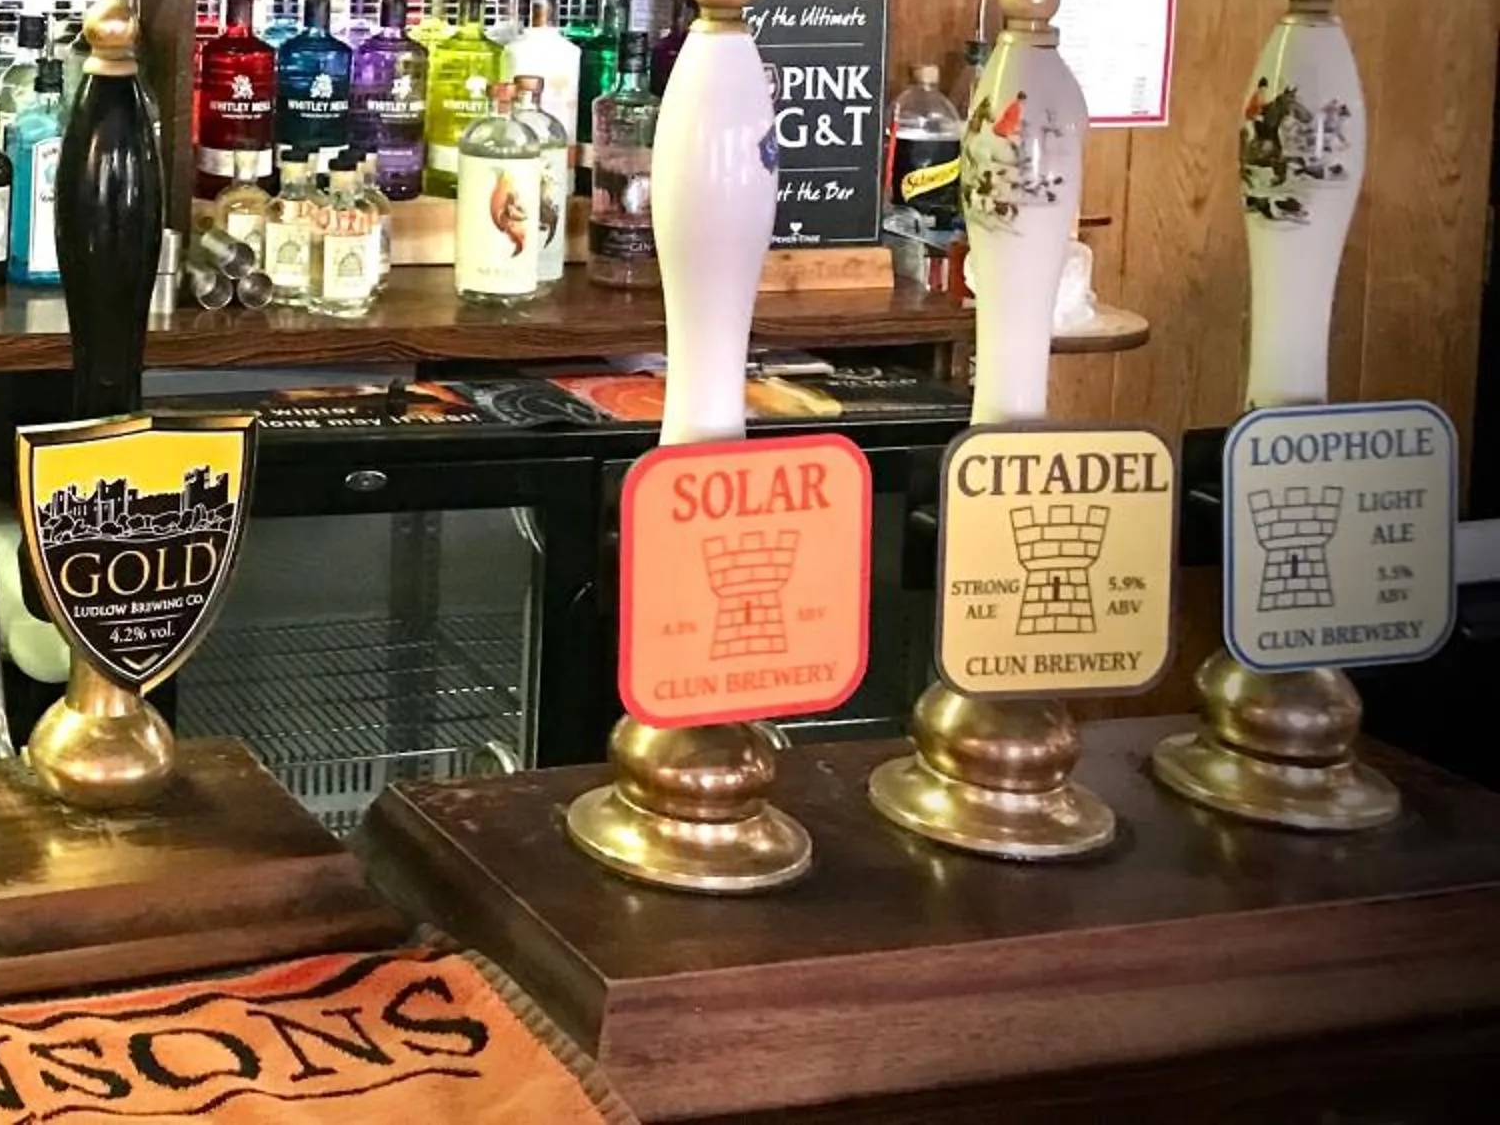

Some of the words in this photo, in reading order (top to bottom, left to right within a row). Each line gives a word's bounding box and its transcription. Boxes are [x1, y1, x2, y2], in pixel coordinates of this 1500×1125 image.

[740, 5, 768, 40] Try
[770, 6, 797, 28] the
[799, 5, 868, 27] Ultimate
[781, 65, 873, 101] PINK
[209, 100, 250, 112] WHITLEY
[288, 99, 329, 113] WHITLEY
[367, 99, 407, 113] WHITLEY
[775, 105, 873, 149] G&T
[796, 182, 821, 202] the
[824, 180, 855, 202] Bar
[629, 242, 651, 252] GIN
[270, 406, 358, 417] winter
[258, 419, 322, 429] long
[328, 418, 381, 427] may
[1249, 427, 1435, 466] LOOPHOLE
[957, 452, 1169, 497] CITADEL
[672, 462, 831, 523] SOLAR
[1358, 488, 1428, 513] LIGHT
[1370, 523, 1415, 545] ALE
[59, 538, 218, 599] GOLD
[951, 578, 1021, 596] STRONG
[1107, 576, 1147, 592] 5.9%
[1378, 587, 1412, 604] ABV
[73, 603, 127, 618] LUDLOW
[130, 596, 184, 615] BREWING
[965, 604, 998, 620] ALE
[1107, 599, 1143, 616] ABV
[109, 626, 148, 644] 4.2%
[1257, 628, 1316, 652] CLUN
[1321, 620, 1424, 647] BREWERY
[965, 654, 1030, 676] CLUN
[1034, 651, 1143, 674] BREWERY
[654, 675, 719, 701] CLUN
[725, 660, 839, 694] BREWERY
